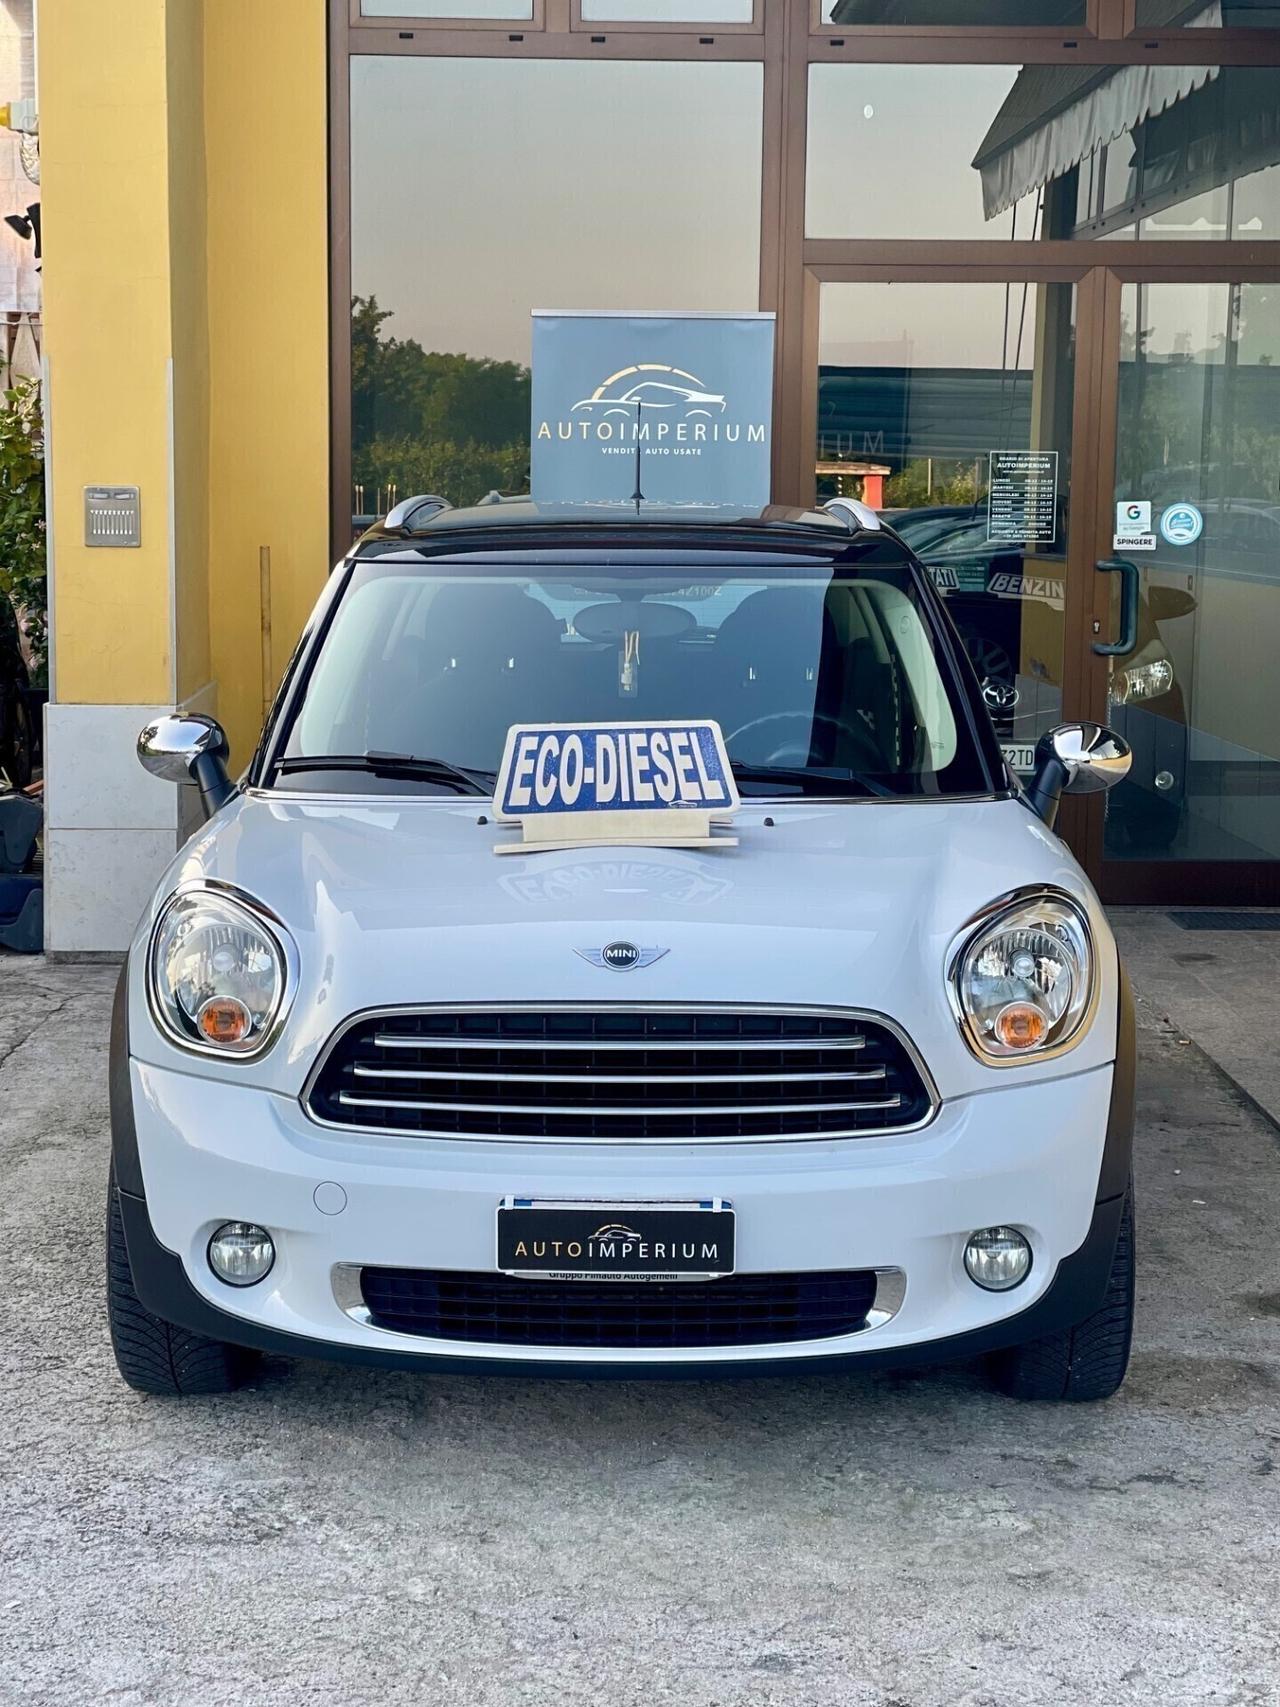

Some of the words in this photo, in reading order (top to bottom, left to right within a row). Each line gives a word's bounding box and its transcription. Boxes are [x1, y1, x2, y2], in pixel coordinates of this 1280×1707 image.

[537, 421, 766, 442] AUTOIMPERIUM
[601, 447, 642, 455] VENDIT
[645, 447, 670, 455] AUTO
[673, 448, 702, 456] USATE
[1116, 537, 1153, 546] SPINGERE
[508, 731, 726, 807] ECO-DIESEL
[606, 949, 637, 958] MINI
[514, 1241, 718, 1259] AUTOIMPERIUM
